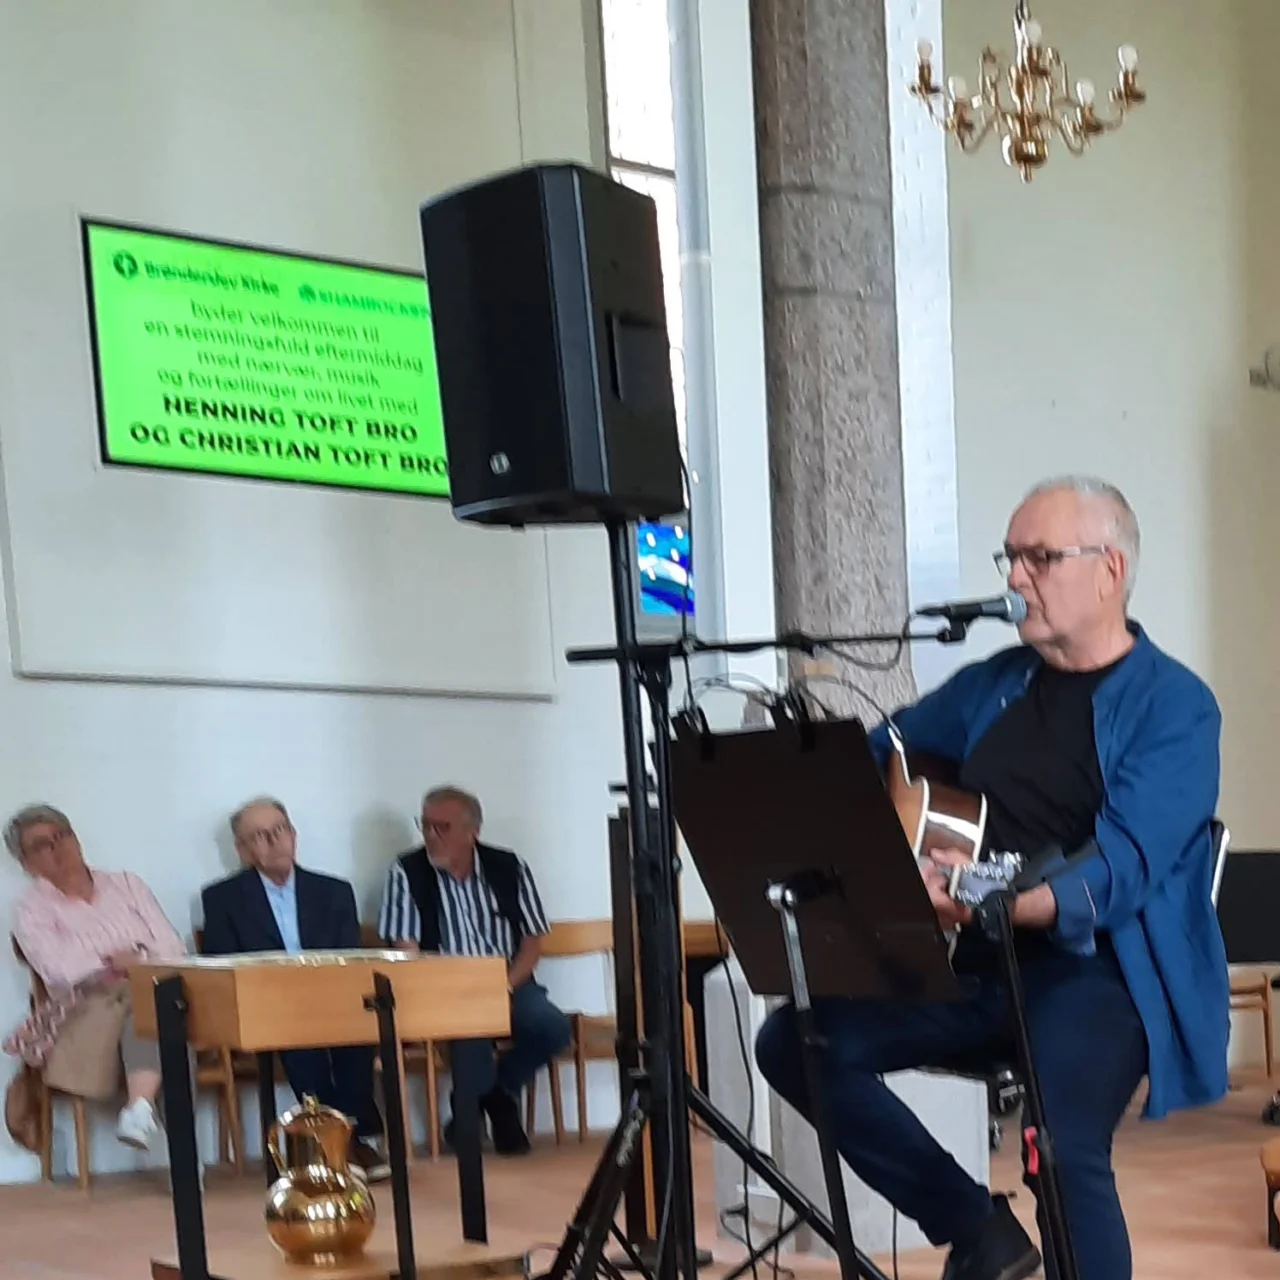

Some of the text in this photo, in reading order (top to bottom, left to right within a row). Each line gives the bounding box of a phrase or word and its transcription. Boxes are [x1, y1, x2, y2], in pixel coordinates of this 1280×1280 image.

[163, 392, 418, 444] HENNING TOFT BRO
[129, 421, 449, 478] OG CHRISTIAN TOFT BRO
